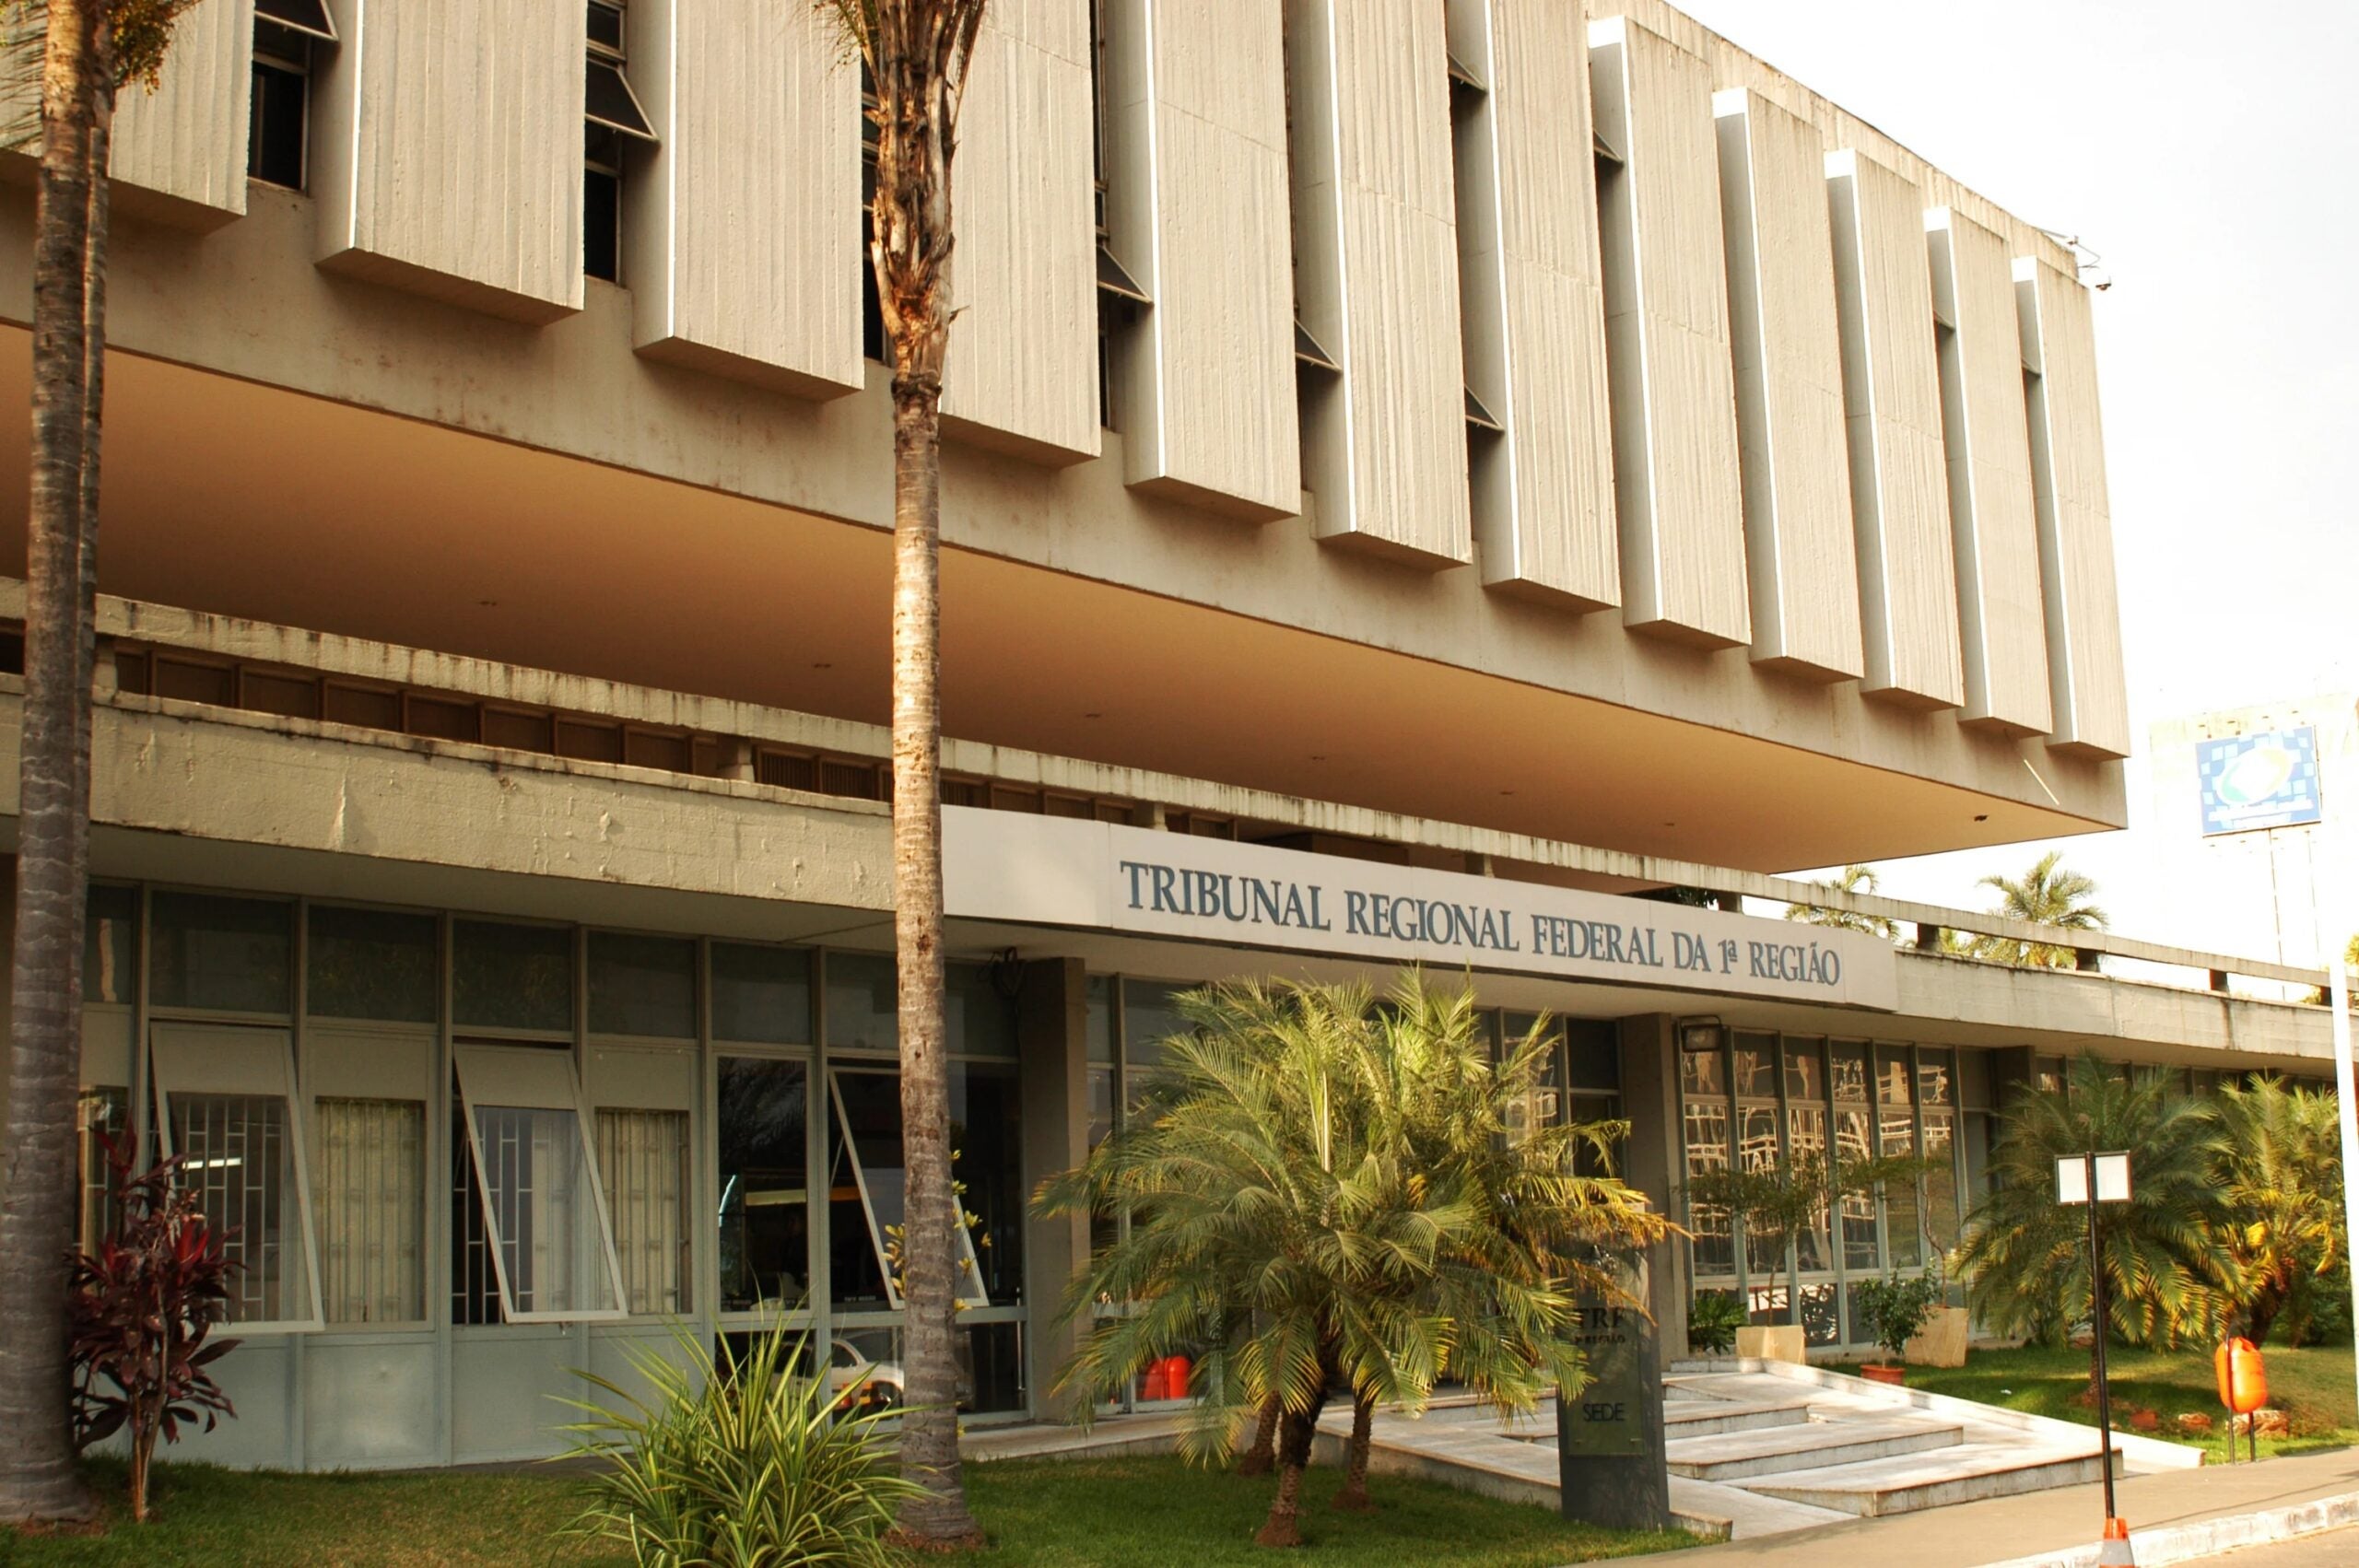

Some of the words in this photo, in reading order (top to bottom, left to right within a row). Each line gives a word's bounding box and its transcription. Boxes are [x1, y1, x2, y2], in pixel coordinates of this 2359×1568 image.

[1120, 860, 1332, 931] TRIBUNAL
[1344, 890, 1520, 952] REGIONAL
[1531, 914, 1663, 967] FEDERAL
[1672, 931, 1711, 972] DA
[1718, 939, 1738, 975] 1ª
[1748, 941, 1840, 986] REGIÃO
[1583, 1402, 1625, 1422] SEDE
